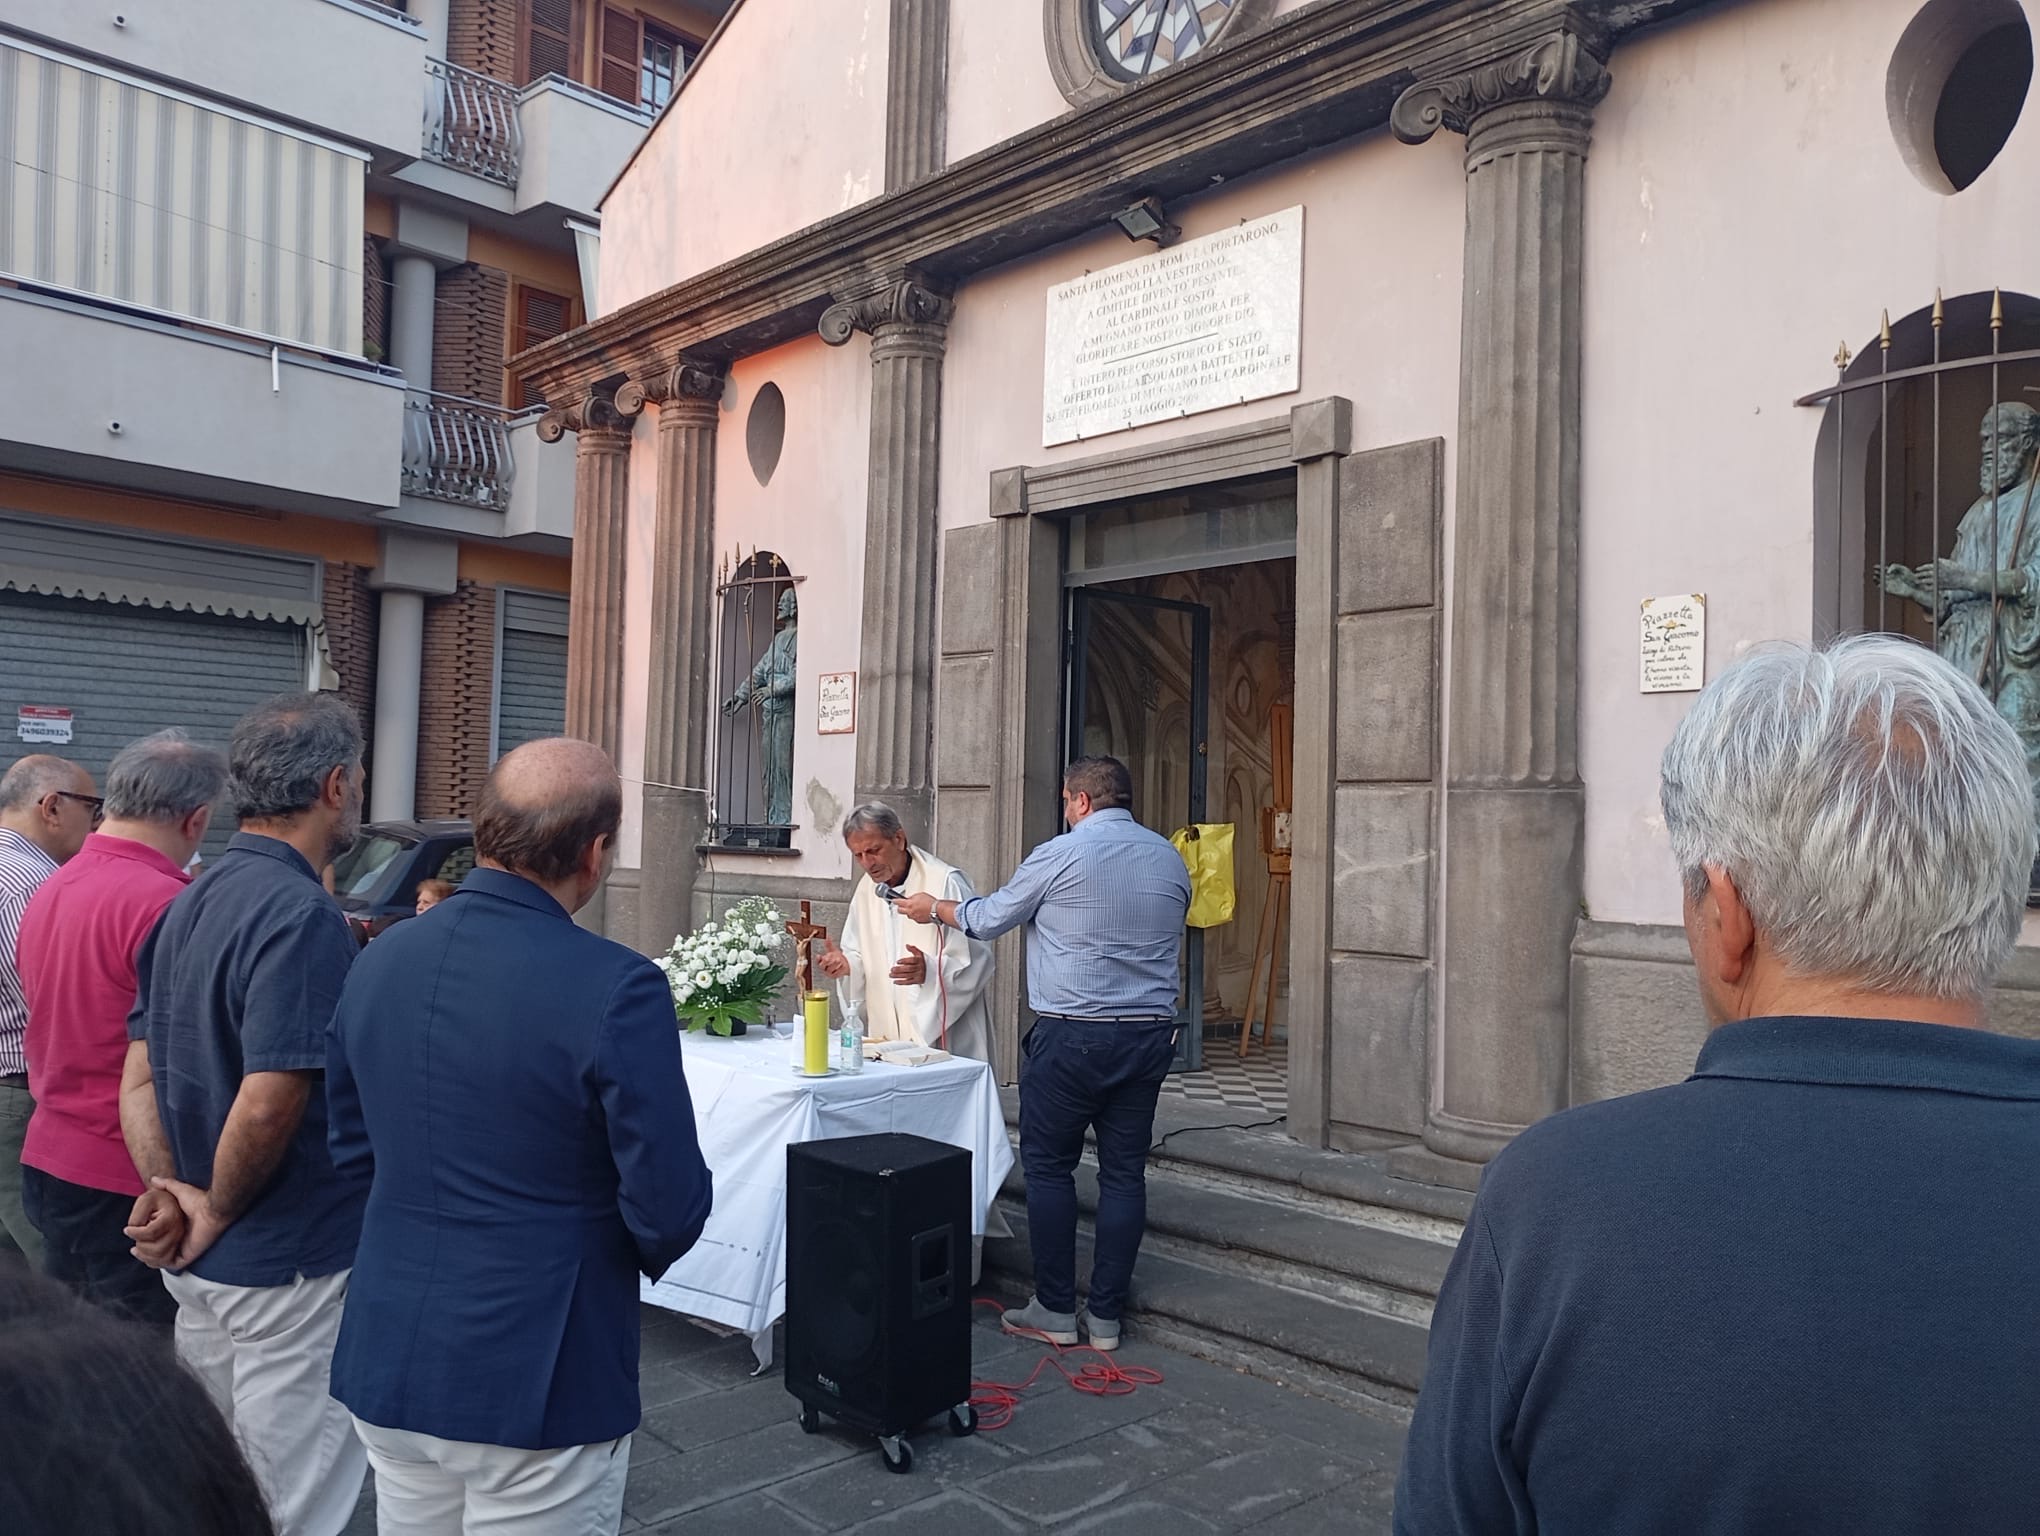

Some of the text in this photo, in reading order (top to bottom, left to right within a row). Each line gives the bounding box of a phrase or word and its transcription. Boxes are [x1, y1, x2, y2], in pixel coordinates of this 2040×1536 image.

[1058, 284, 1088, 301] SANTA
[1090, 268, 1140, 292] FILOMENA
[1142, 263, 1156, 275] DA
[1160, 250, 1190, 269] ROMA
[1101, 292, 1107, 302] A
[1110, 278, 1147, 300] NAPOLI
[1148, 274, 1162, 287] LA
[1082, 339, 1088, 350] A
[1091, 323, 1142, 345] MUGNANO
[1184, 300, 1227, 321] DIMORA
[1230, 292, 1251, 308] PER
[1088, 311, 1094, 320] A
[1096, 295, 1138, 317] CIMITILE
[1105, 315, 1119, 329] AL
[1121, 299, 1179, 324] CARDINALE
[1076, 339, 1141, 364] GLORIFICARE
[1117, 354, 1169, 377] PERCORSO
[1170, 342, 1215, 361] STORICO
[1228, 330, 1262, 348] STATO
[1063, 386, 1105, 404] OFFERTO
[1201, 347, 1254, 371] BATTENTI
[1257, 343, 1270, 357] DI
[1077, 396, 1128, 416] FILOMENA
[1130, 390, 1140, 402] DI
[1200, 371, 1221, 386] DEL
[1223, 354, 1292, 378] CARDINALE
[1643, 605, 1693, 629] Piazzetta
[1643, 629, 1699, 645] San Giacomo
